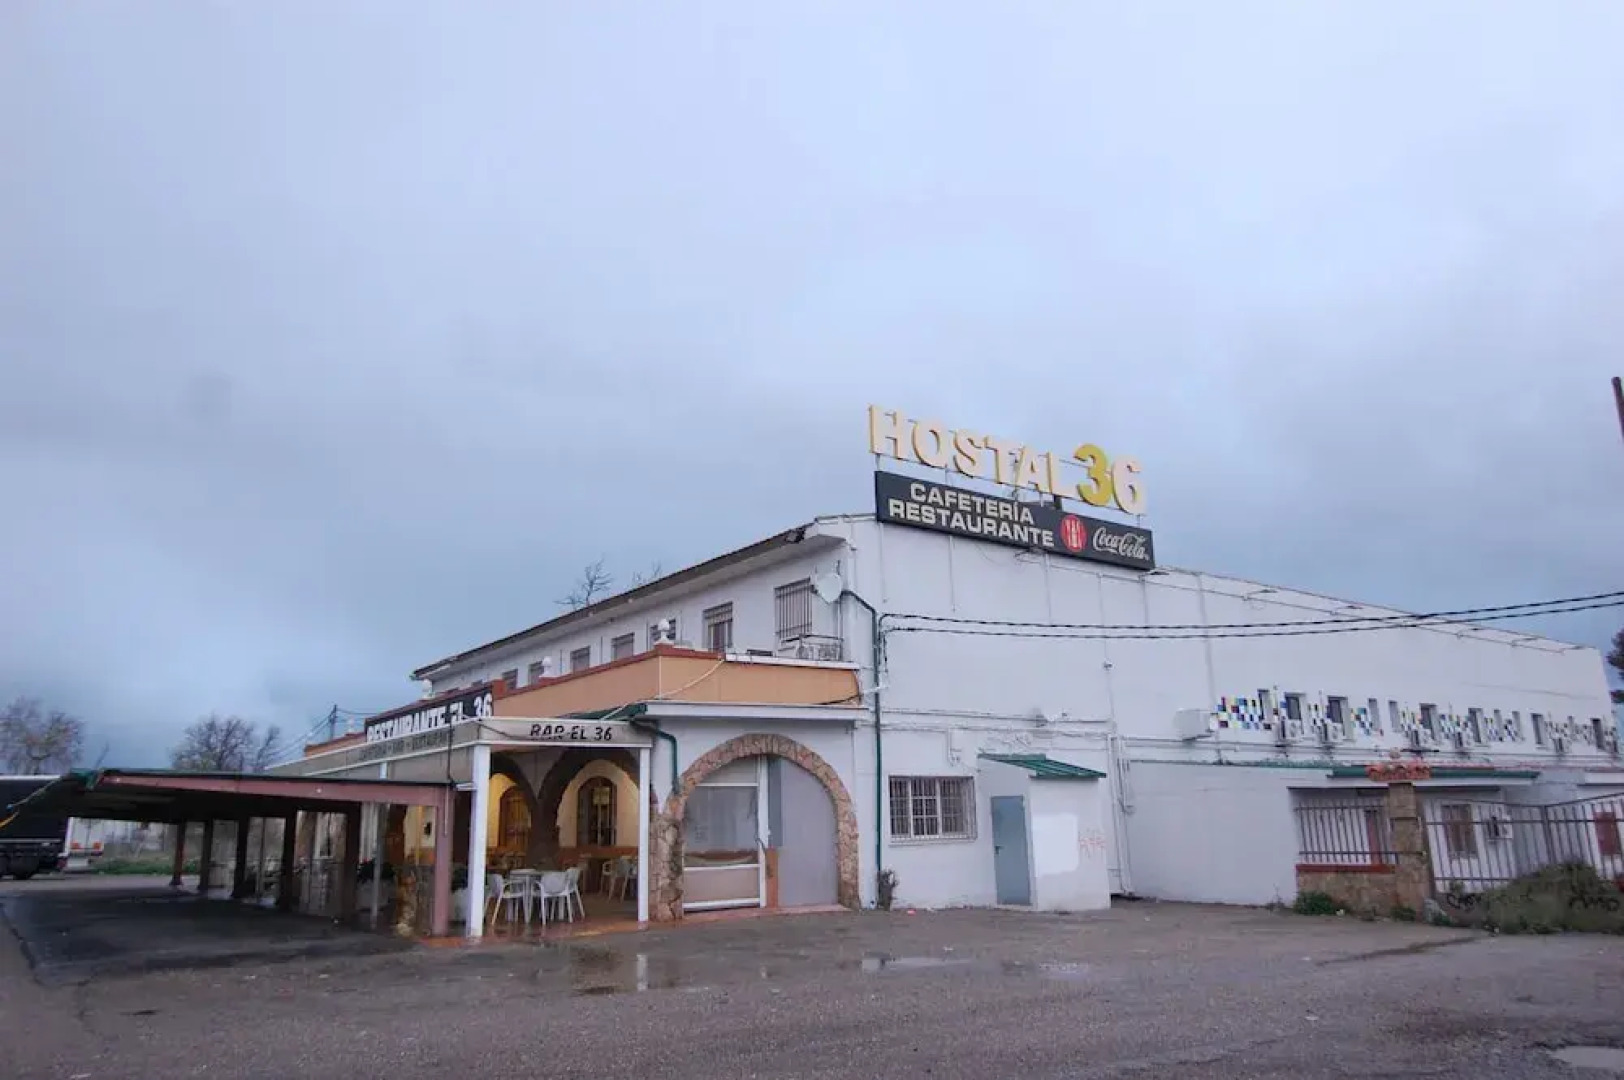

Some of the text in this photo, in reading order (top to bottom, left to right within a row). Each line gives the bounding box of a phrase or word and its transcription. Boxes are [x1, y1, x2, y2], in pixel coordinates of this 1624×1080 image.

[869, 404, 1147, 515] HOSTAL 36
[889, 499, 1055, 548] RESTAURANTE
[910, 483, 1034, 525] CAFETERÍA
[474, 693, 493, 718] 36
[570, 725, 587, 739] EL
[595, 727, 612, 740] 36
